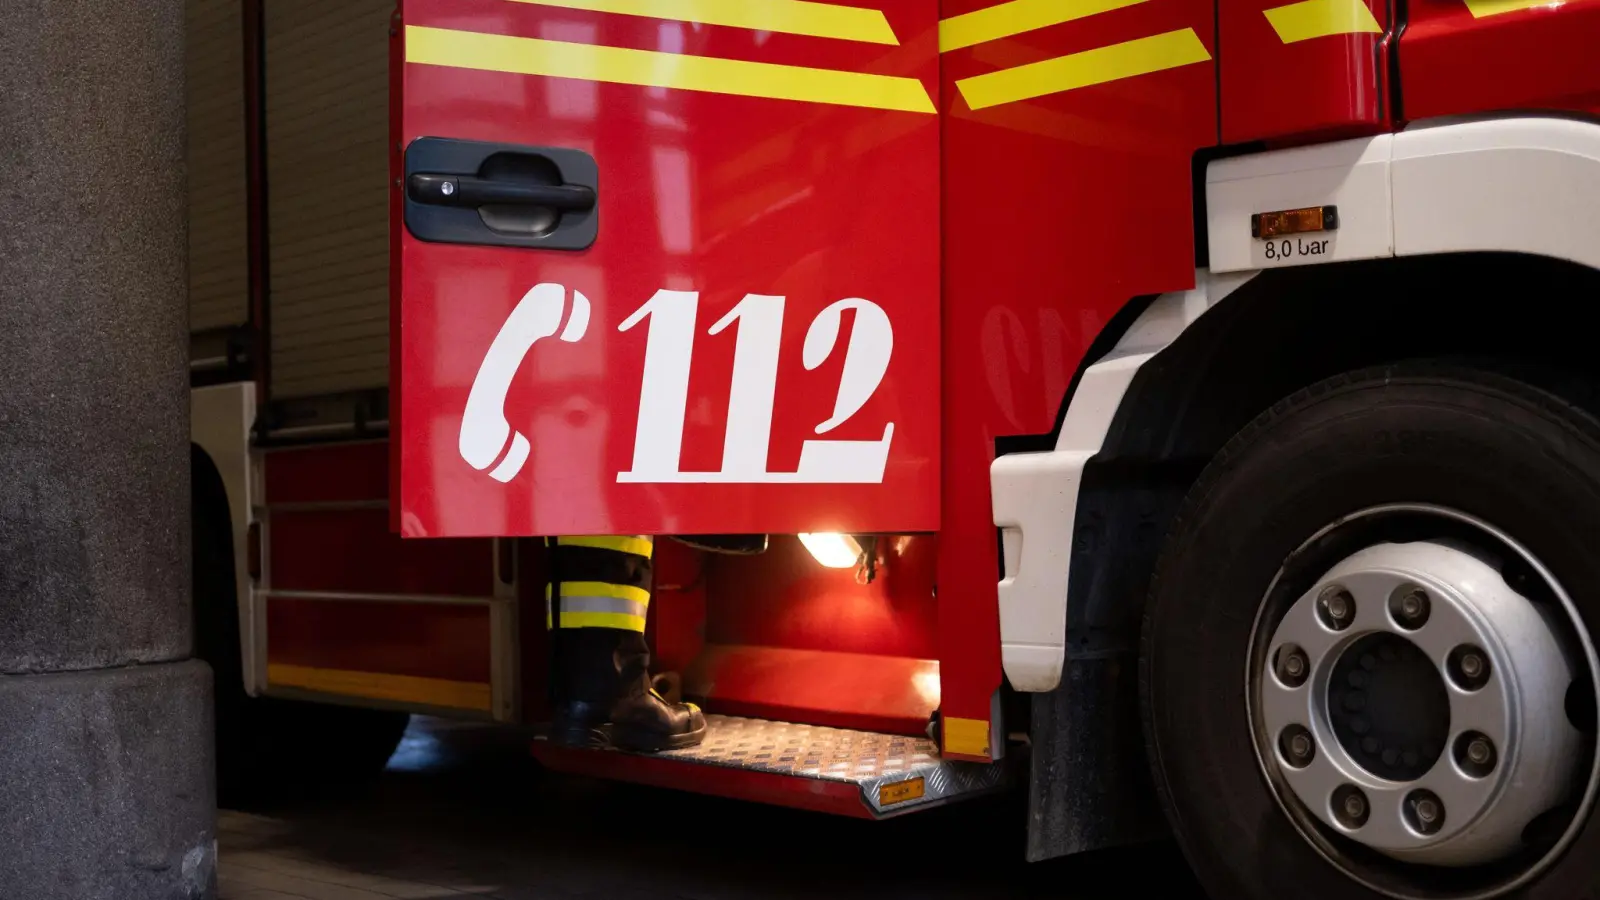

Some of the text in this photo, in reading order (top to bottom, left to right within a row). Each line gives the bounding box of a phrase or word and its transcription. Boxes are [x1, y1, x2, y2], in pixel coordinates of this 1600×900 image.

[1265, 239, 1329, 261] 8,0 bar
[616, 288, 895, 484] 112
